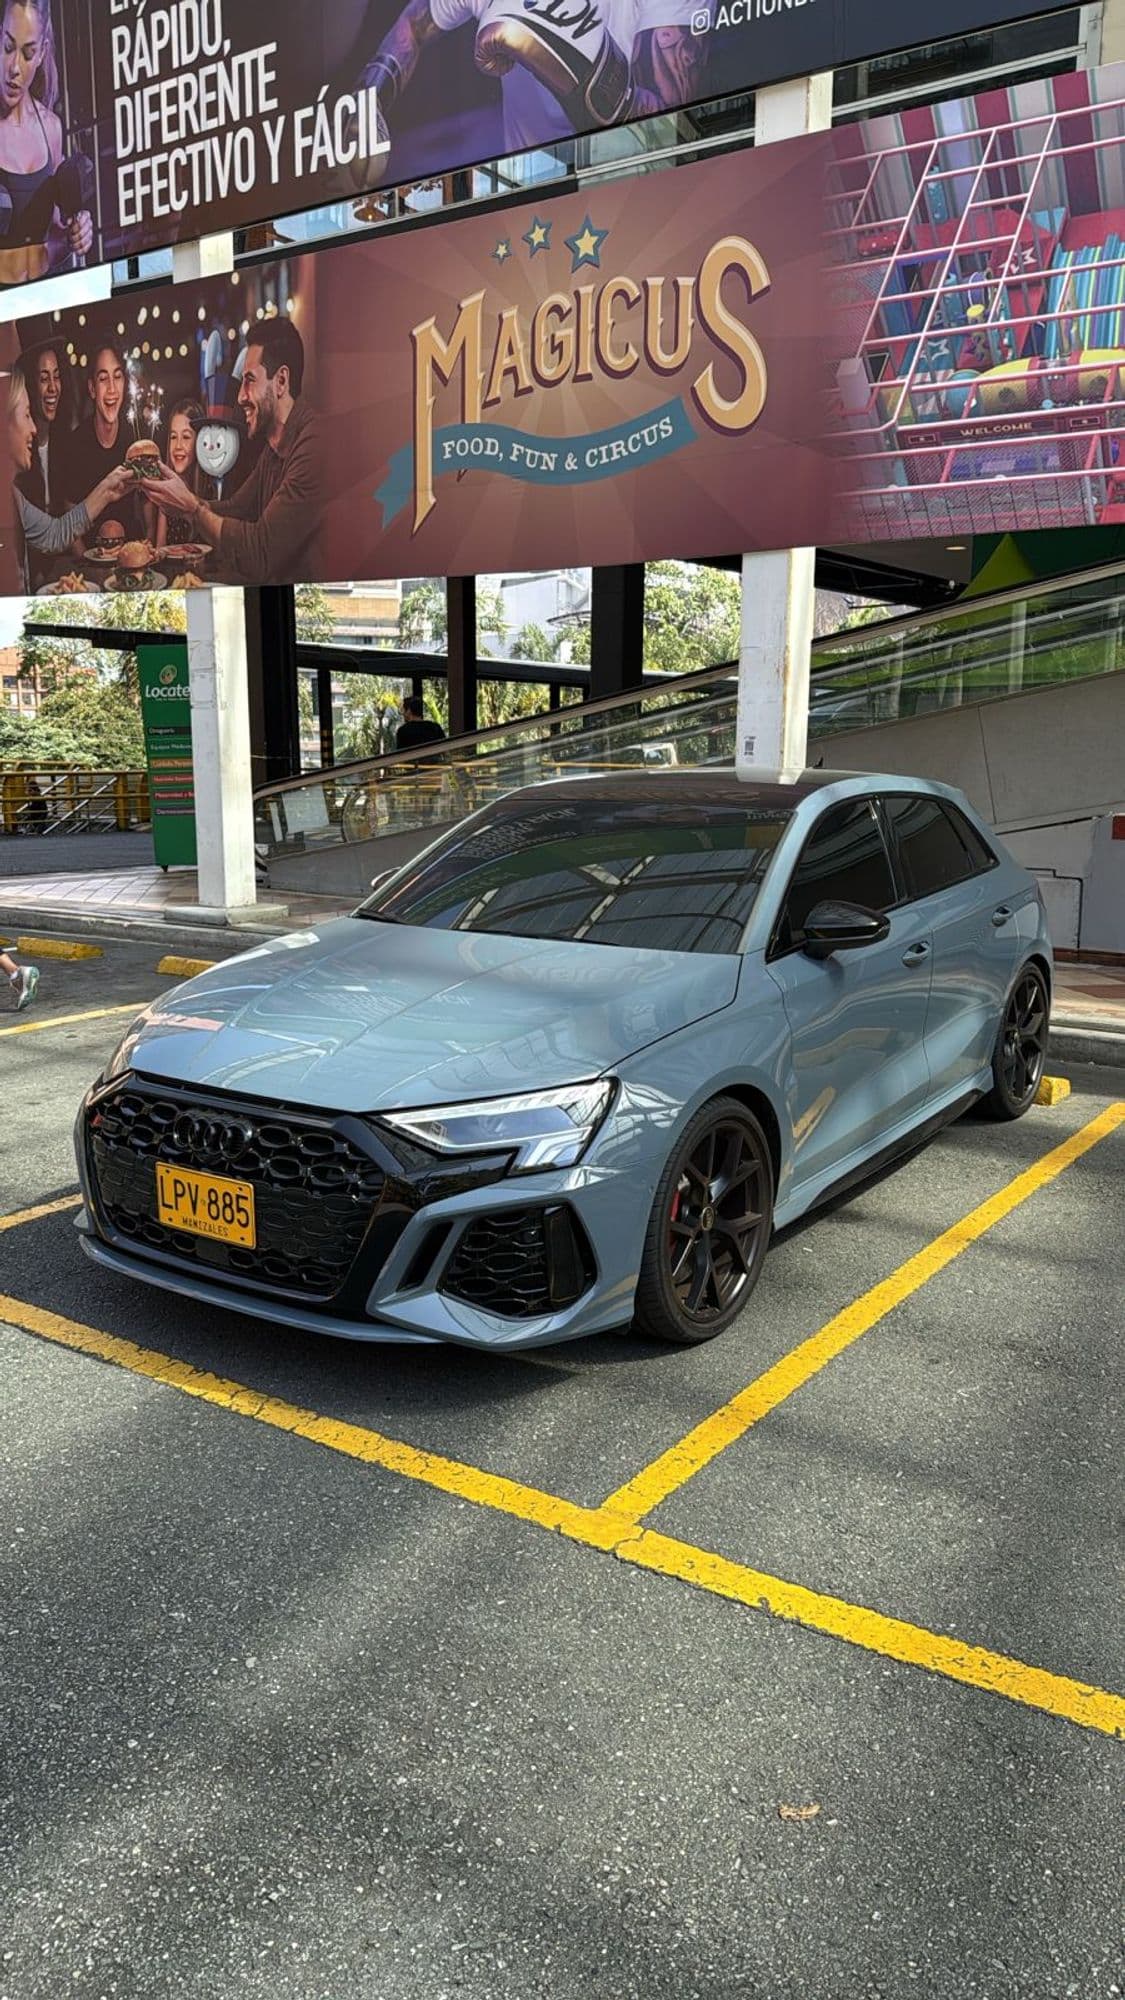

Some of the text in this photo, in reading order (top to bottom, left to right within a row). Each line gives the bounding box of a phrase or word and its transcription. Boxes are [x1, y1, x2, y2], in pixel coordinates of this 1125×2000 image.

[111, 0, 231, 90] RÁPIDO,
[115, 41, 279, 159] DIFERENTE
[117, 85, 391, 228] EFECTIVO Y FÁCIL
[410, 235, 771, 536] MAGICUS
[960, 422, 1032, 437] WELCOME
[443, 417, 674, 471] FOOD, FUN & CIRCUS
[145, 684, 191, 698] Locate
